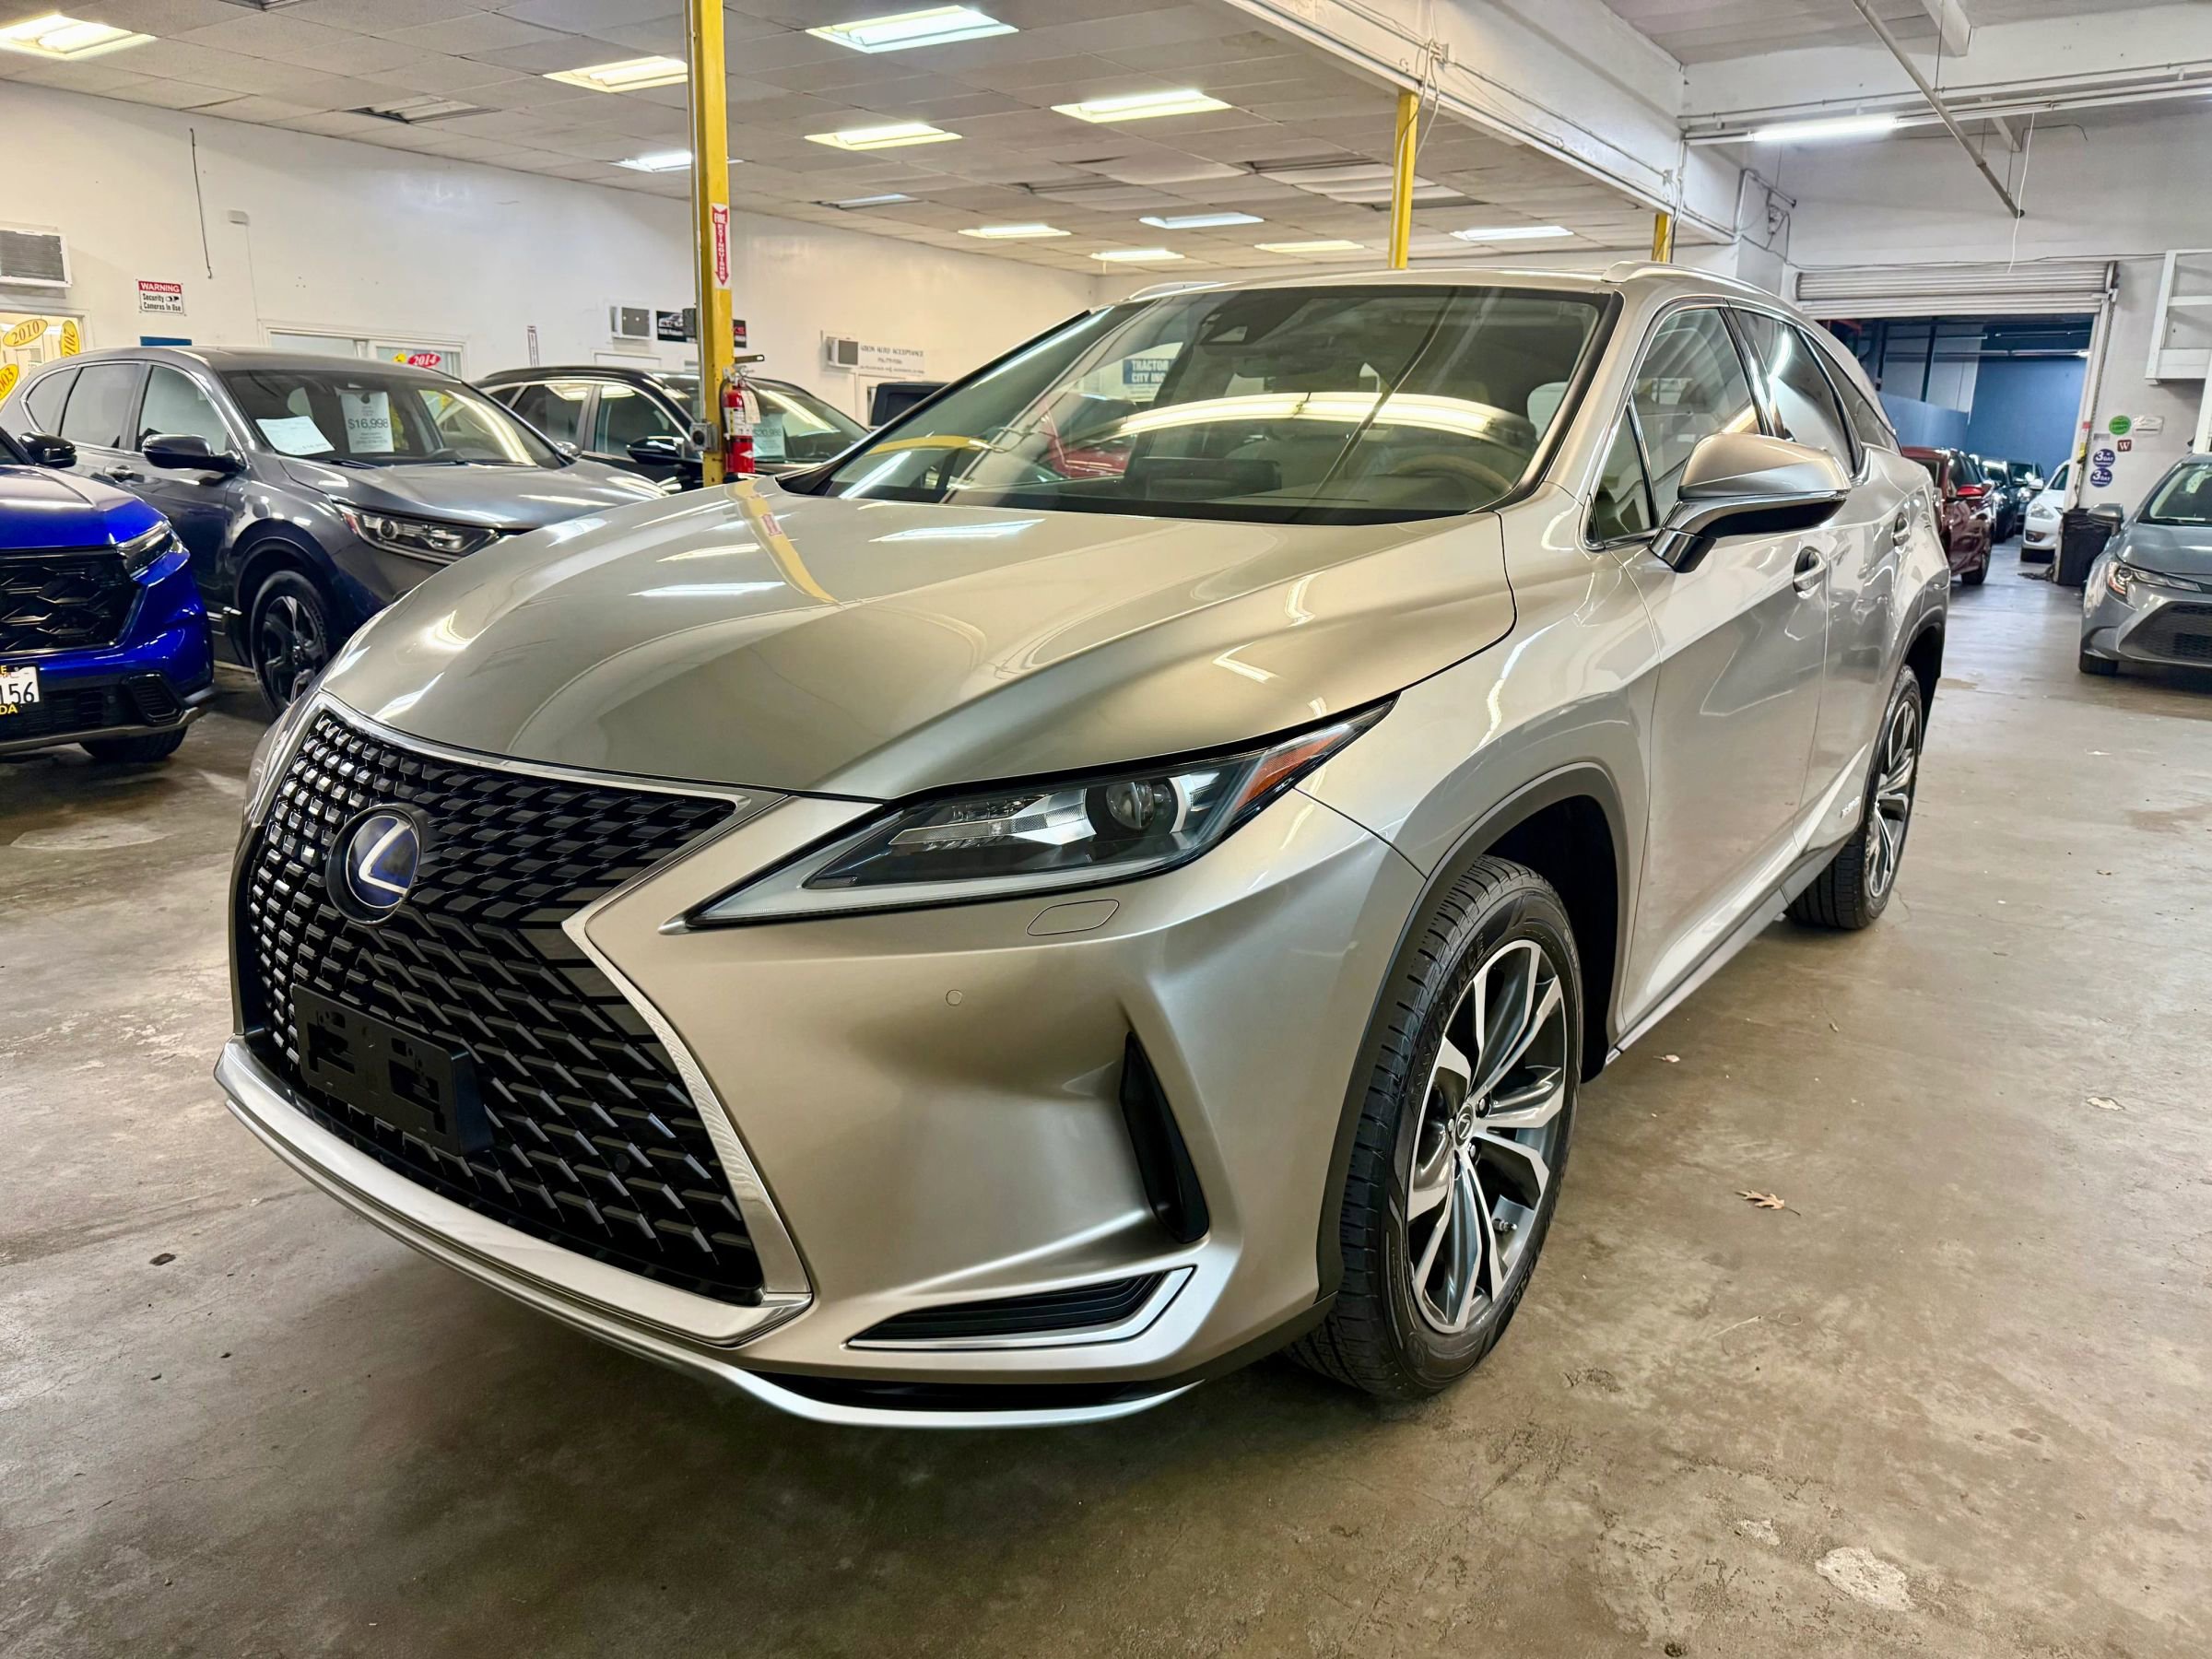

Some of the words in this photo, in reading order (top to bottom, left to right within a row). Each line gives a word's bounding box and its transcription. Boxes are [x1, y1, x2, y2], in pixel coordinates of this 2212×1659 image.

[714, 213, 725, 223] FIRE
[140, 282, 180, 292] WARNING
[143, 293, 164, 302] Security
[11, 320, 40, 345] 2010
[414, 355, 437, 366] 2014
[1132, 360, 1169, 371] TRACTOR
[1132, 372, 1149, 382] CITY
[2095, 451, 2104, 461] 3
[2092, 470, 2101, 480] 3
